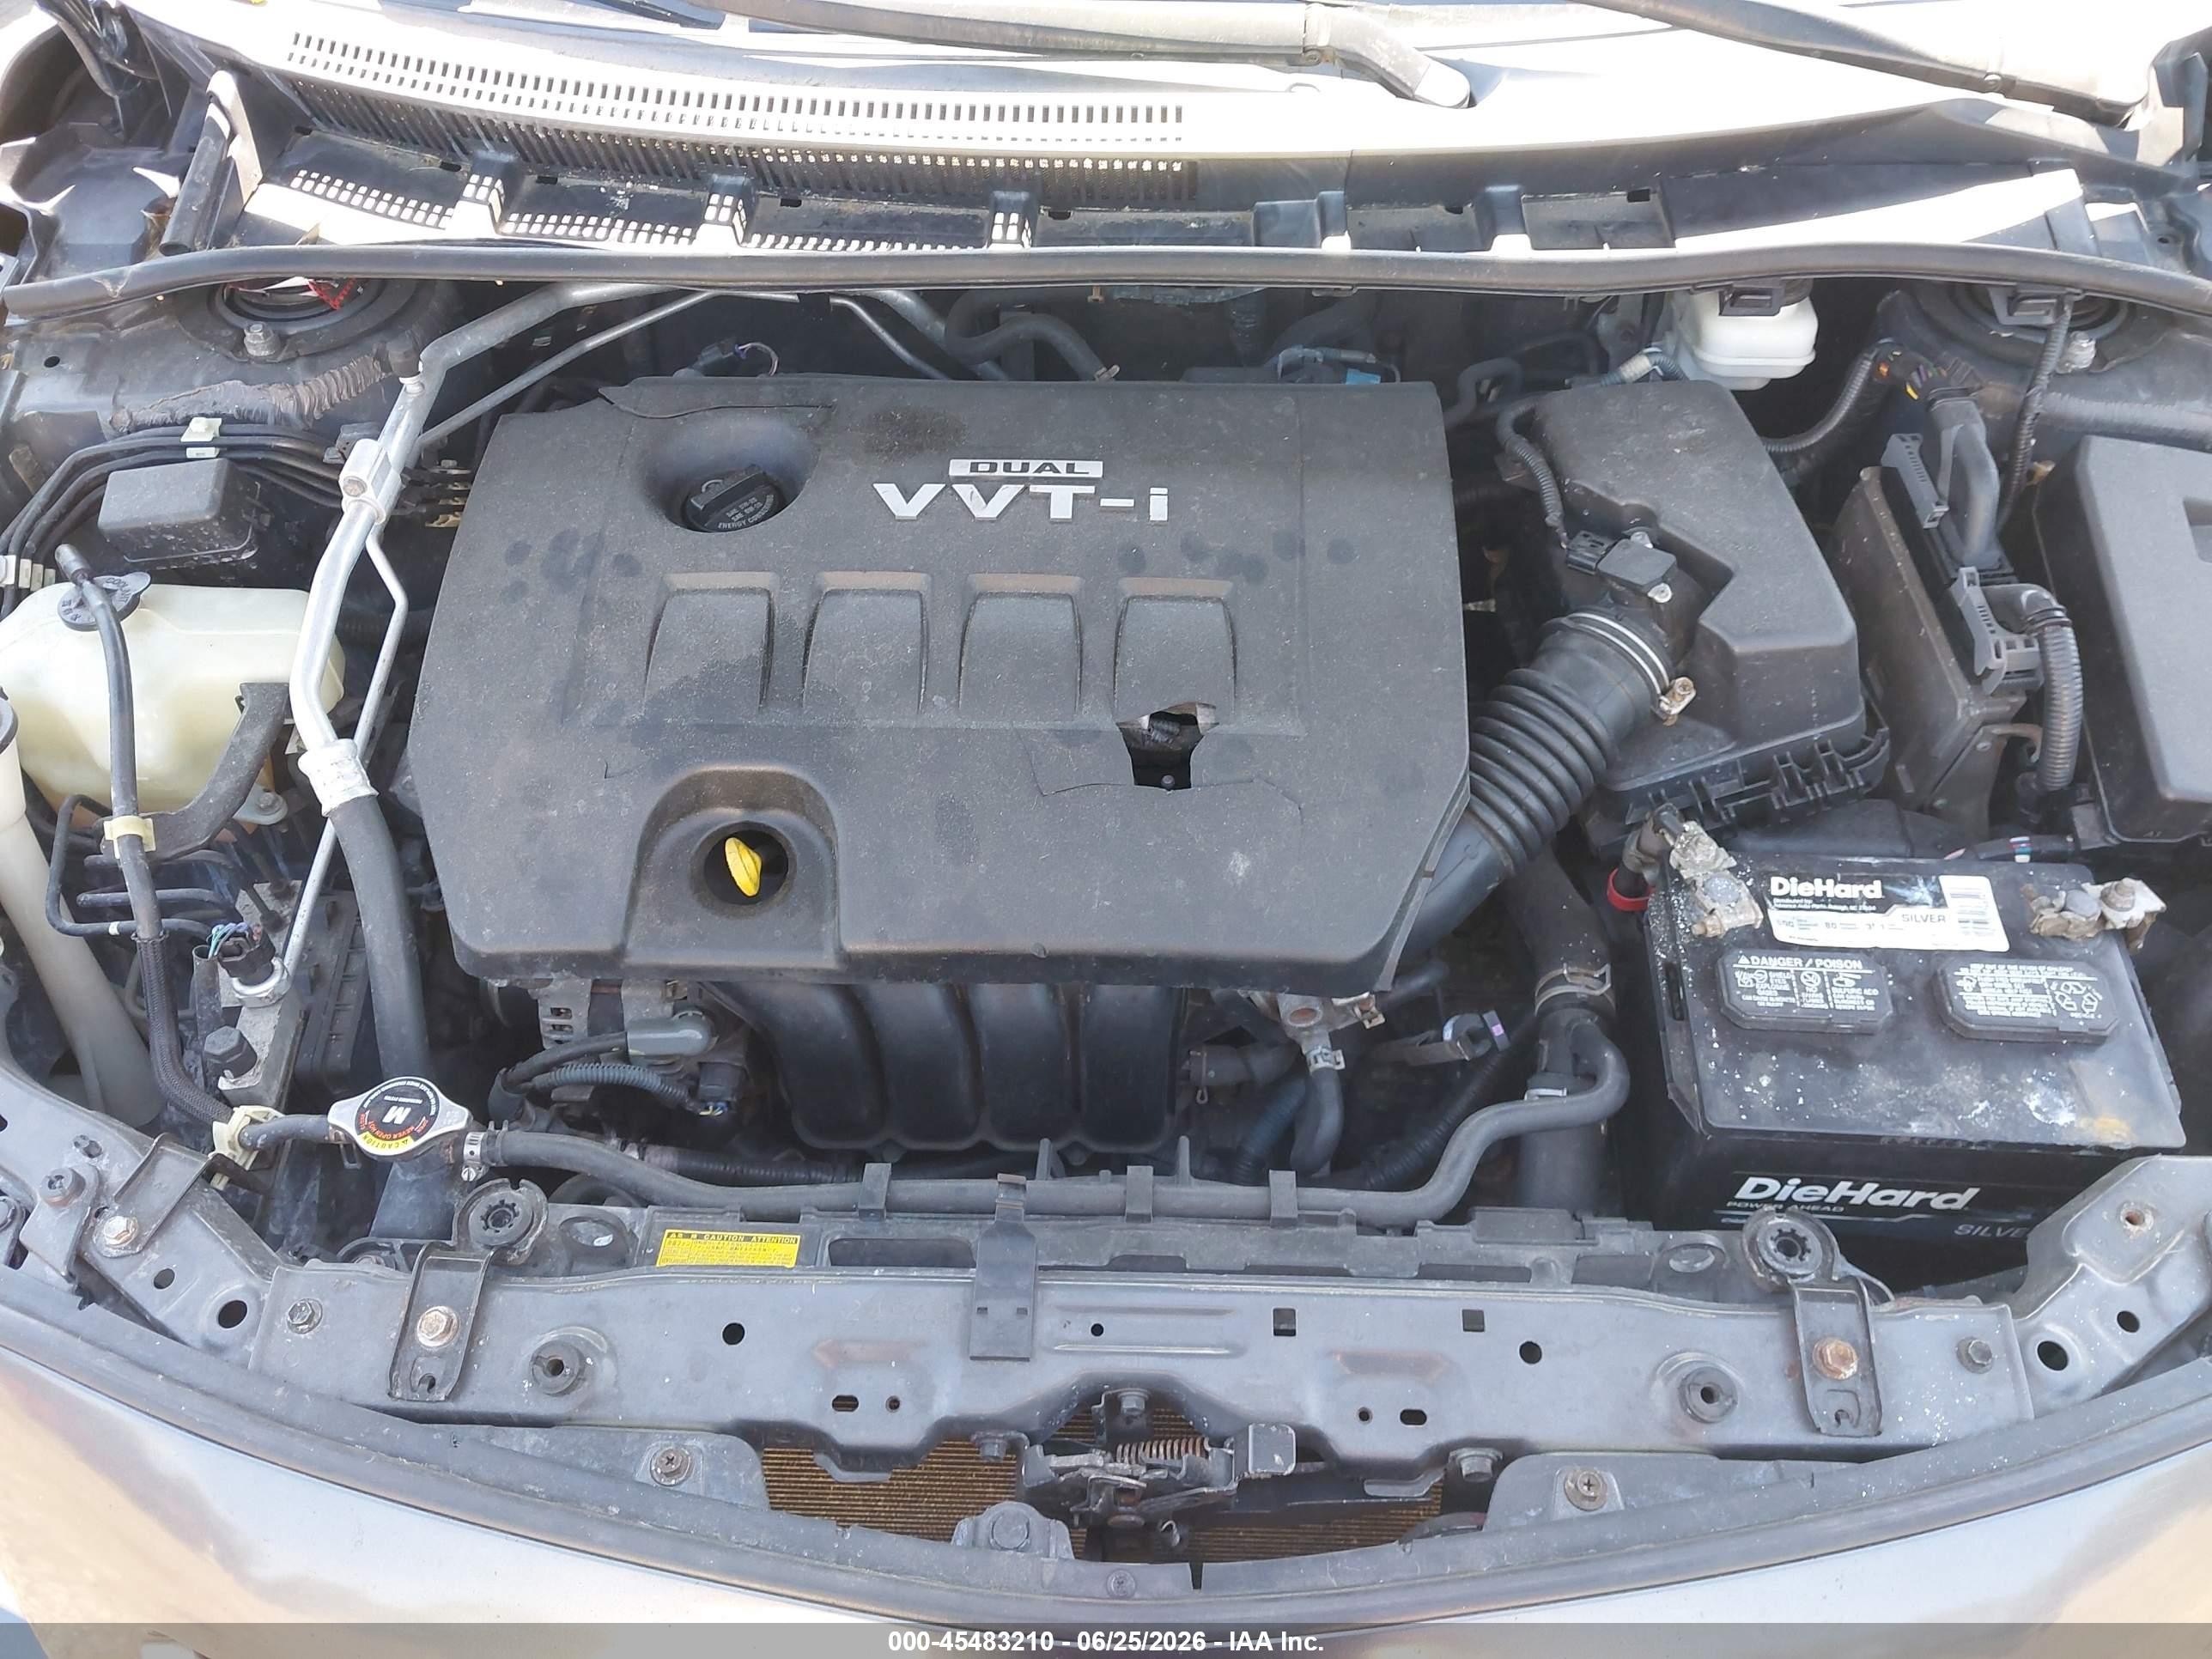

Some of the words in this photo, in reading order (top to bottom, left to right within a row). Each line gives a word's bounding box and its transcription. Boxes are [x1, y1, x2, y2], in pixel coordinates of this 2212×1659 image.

[969, 461, 1090, 474] DUAL
[872, 483, 1169, 521] VVT-i
[1770, 876, 1883, 899] DieHard
[1901, 913, 1947, 924] SILVER
[1750, 955, 1803, 968] DANGER
[1805, 957, 1814, 968] /
[1814, 958, 1863, 970] POISON
[362, 1134, 399, 1150] CAUTION
[1735, 1176, 1980, 1211] DieHard
[703, 1232, 744, 1242] CAUTION
[750, 1235, 797, 1244] ATTENTION
[1954, 1223, 2028, 1238] SILVE
